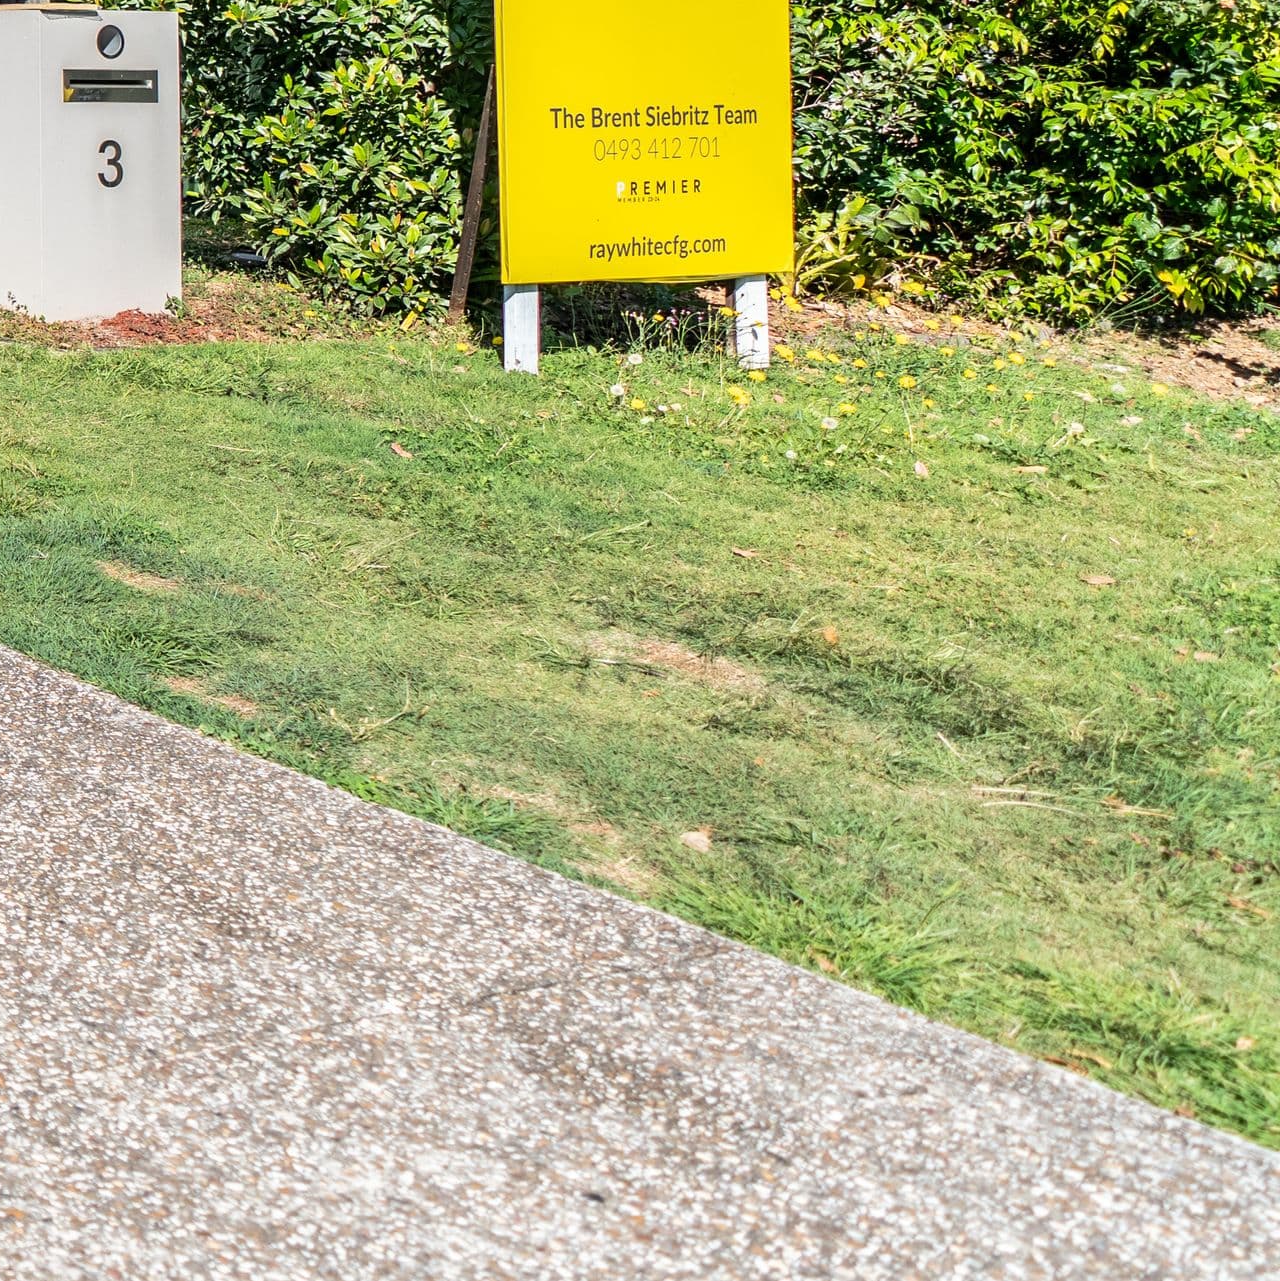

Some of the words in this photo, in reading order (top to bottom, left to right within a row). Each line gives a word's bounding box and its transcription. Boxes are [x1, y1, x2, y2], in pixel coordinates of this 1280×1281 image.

[549, 107, 585, 129] The
[591, 106, 641, 128] Brent
[645, 105, 709, 127] Siebritz
[713, 104, 757, 125] Team
[593, 138, 642, 162] 0493
[647, 136, 682, 160] 412
[688, 136, 721, 158] 701
[97, 139, 123, 188] 3
[616, 179, 701, 198] PREMIER
[589, 235, 726, 262] raywhitecfg.com
